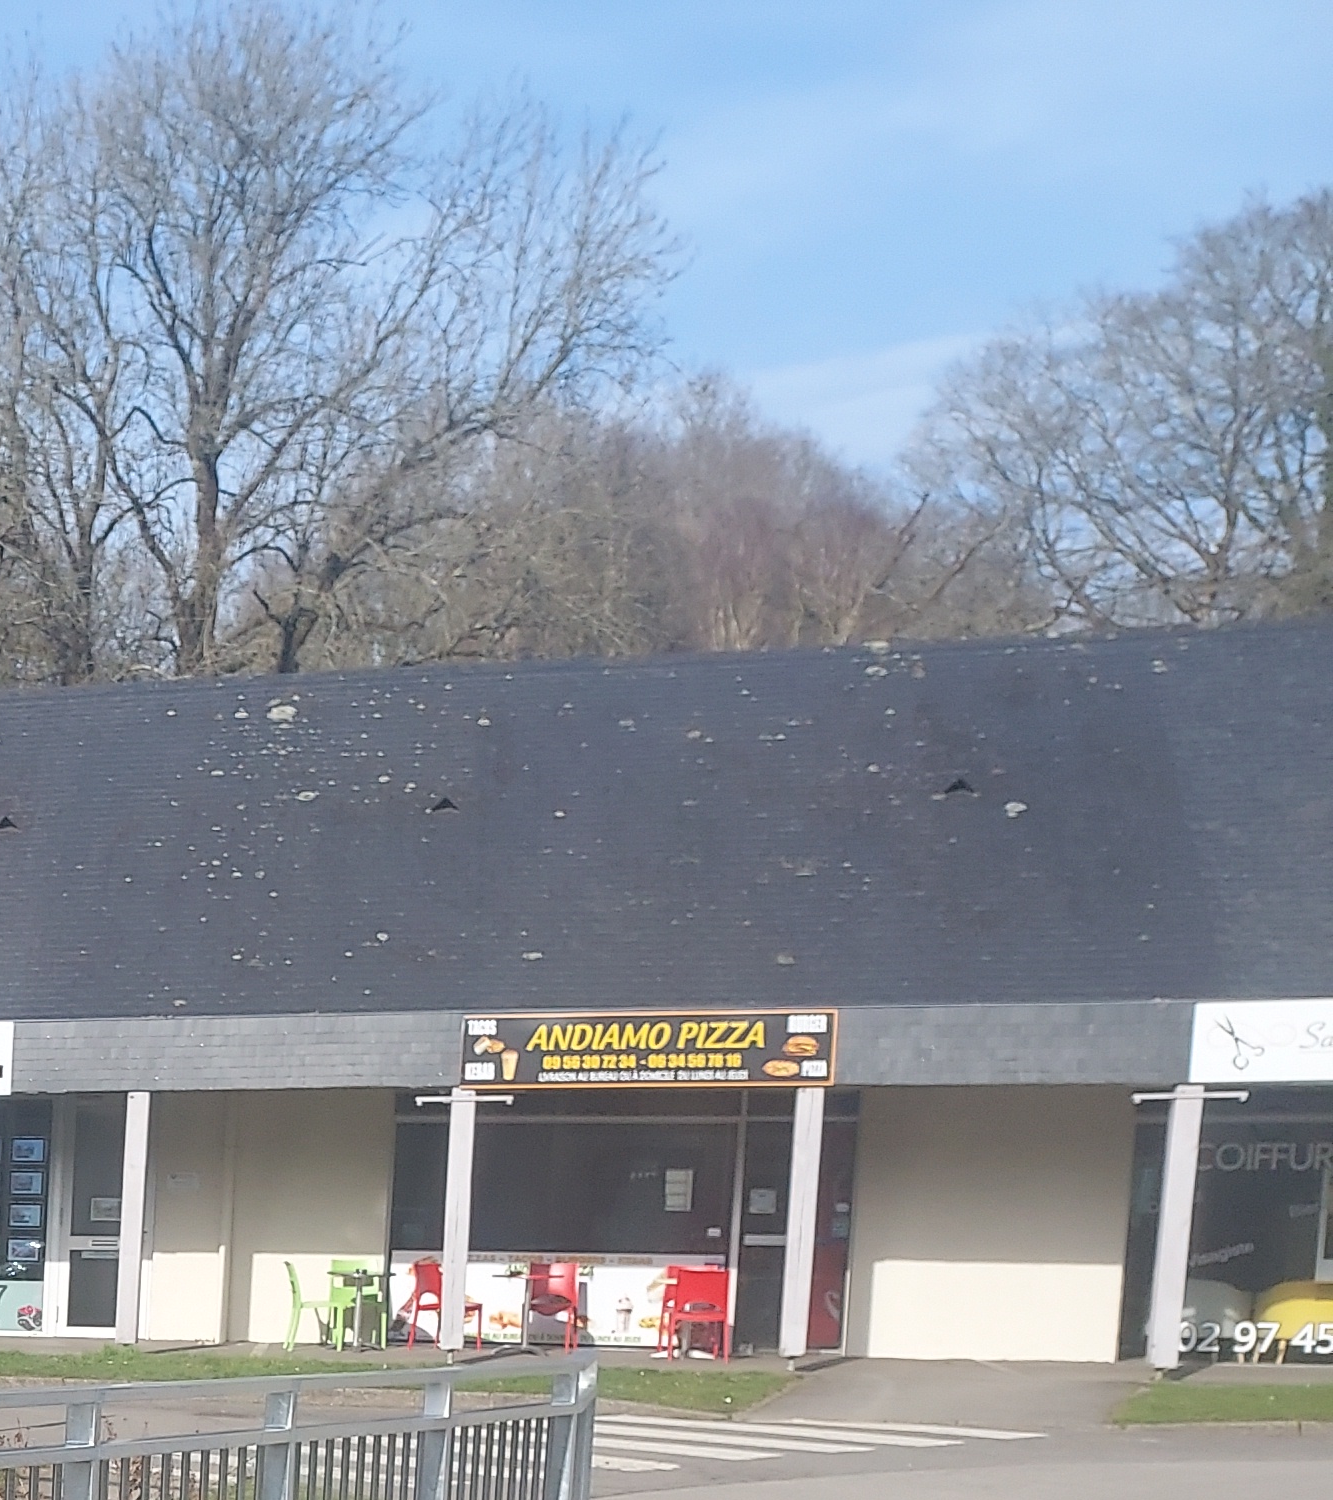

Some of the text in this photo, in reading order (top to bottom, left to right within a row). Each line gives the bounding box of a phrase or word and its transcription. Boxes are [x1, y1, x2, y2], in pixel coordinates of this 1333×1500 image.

[525, 1020, 766, 1051] ANDIAMO PIZZA
[601, 1053, 618, 1069] 72
[1179, 1320, 1333, 1355] 02 97 45
